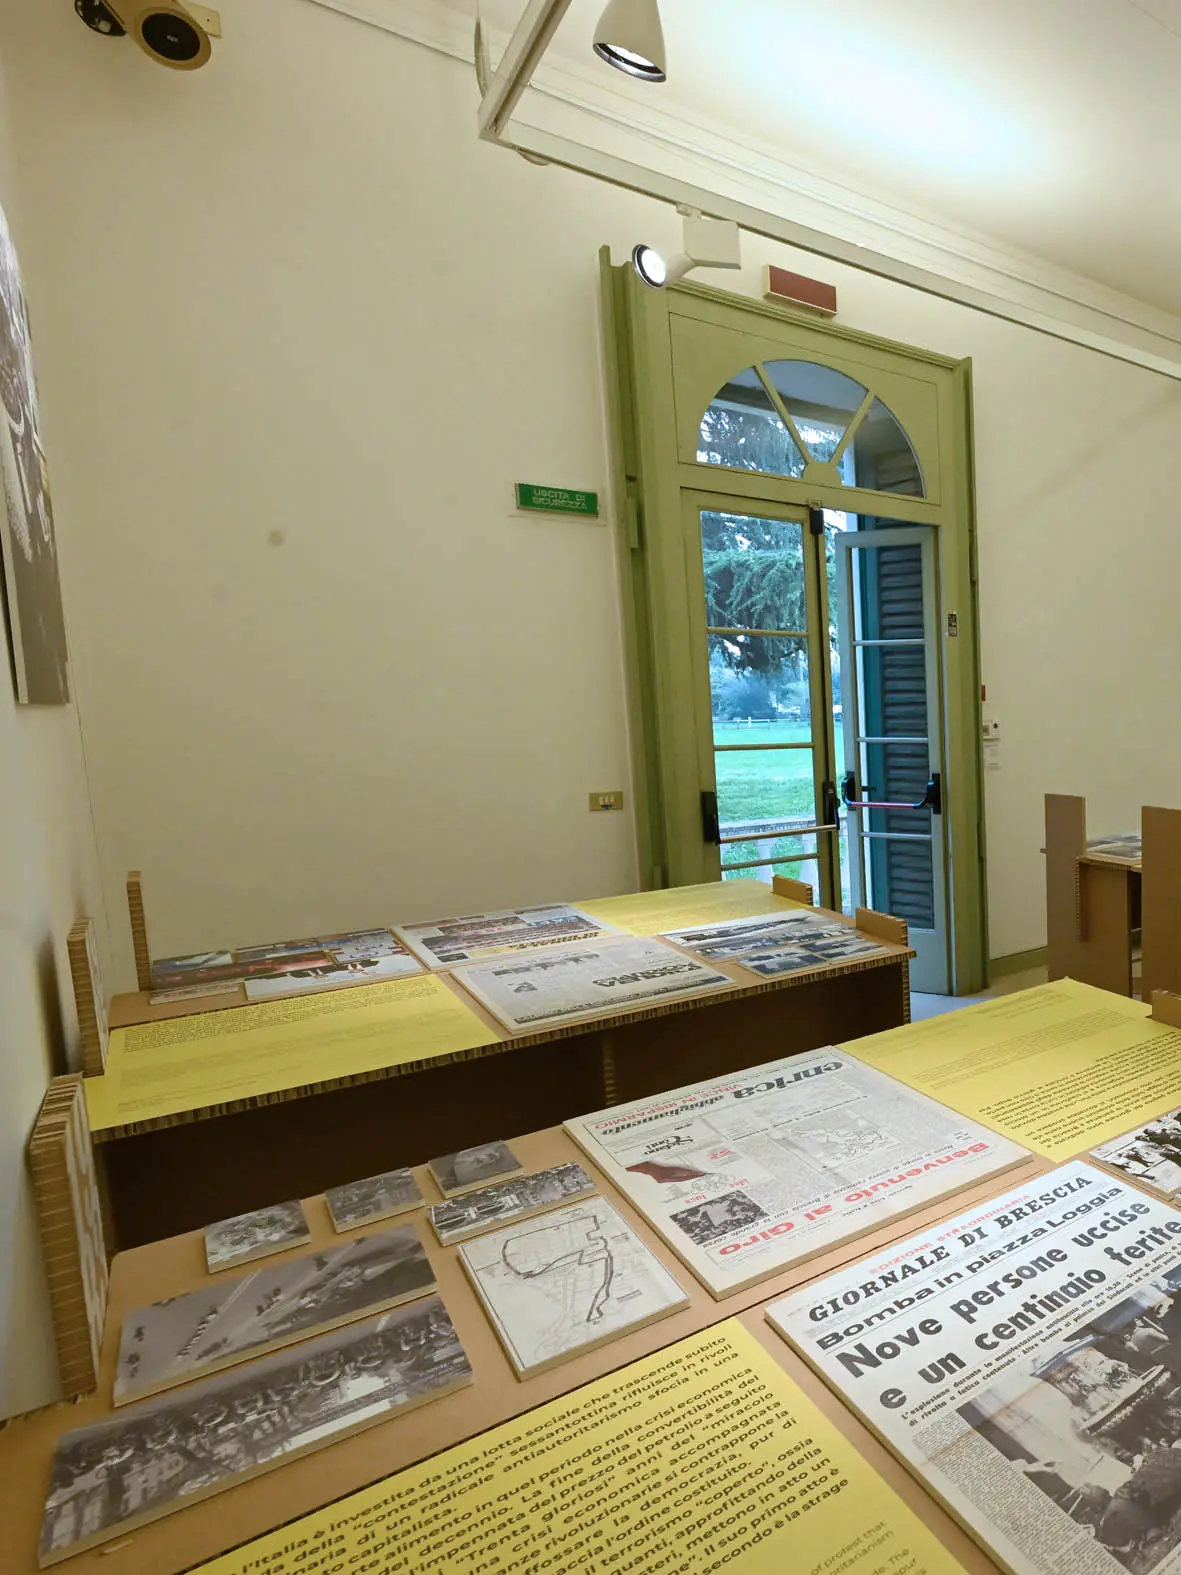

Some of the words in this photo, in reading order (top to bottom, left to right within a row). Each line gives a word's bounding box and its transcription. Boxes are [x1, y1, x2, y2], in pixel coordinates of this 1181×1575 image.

[533, 488, 569, 500] USCITA
[731, 1062, 843, 1099] enrica
[804, 1204, 832, 1221] al
[844, 1142, 988, 1202] Benvenuto
[719, 1222, 795, 1255] Giro
[809, 1245, 950, 1322] GIORNALE
[957, 1226, 989, 1248] DI
[993, 1177, 1093, 1229] BRESCIA
[816, 1288, 935, 1350] Bomba
[934, 1272, 964, 1288] in
[965, 1227, 1048, 1274] piazza
[1045, 1188, 1123, 1228] Loggia
[835, 1318, 943, 1378] Nove
[949, 1249, 1068, 1324] persone
[1071, 1203, 1150, 1247] uccise
[879, 1388, 907, 1409] e
[918, 1352, 967, 1384] un
[971, 1269, 1106, 1351] centinaio
[921, 1401, 947, 1419] rivolta
[1022, 1343, 1039, 1355] Altre
[953, 1369, 982, 1388] durante
[294, 1534, 345, 1563] della
[510, 1401, 617, 1456] sessantottina
[622, 1371, 678, 1401] rifluisce
[682, 1363, 696, 1372] in
[700, 1343, 732, 1363] rivoli
[330, 1487, 415, 1532] investita
[419, 1475, 442, 1488] da
[446, 1456, 479, 1475] una
[482, 1436, 522, 1457] lotta
[525, 1408, 580, 1437] sociale
[583, 1393, 610, 1409] che
[612, 1358, 683, 1394] trascende
[685, 1338, 726, 1359] subito
[357, 1530, 376, 1545] di
[386, 1515, 411, 1531] un
[421, 1474, 494, 1514] radicale
[503, 1401, 642, 1473] antiautoritarismo
[647, 1377, 690, 1400] sfocia
[694, 1368, 708, 1376] in
[713, 1353, 739, 1367] una
[385, 1512, 472, 1561] alimento
[475, 1501, 493, 1513] in
[496, 1477, 535, 1502] quel
[538, 1445, 602, 1482] periodo
[605, 1424, 643, 1446] nella
[645, 1406, 675, 1425] crisi
[677, 1368, 752, 1409] economica
[419, 1507, 513, 1557] decennio.
[521, 1490, 542, 1503] La
[549, 1468, 584, 1488] fine
[591, 1444, 630, 1466] della
[637, 1390, 733, 1442] convertibilità
[738, 1375, 759, 1389] del
[512, 1525, 552, 1552] crisi
[563, 1468, 660, 1524] economica
[669, 1401, 781, 1466] accompagnata
[529, 1494, 557, 1513] del
[559, 1465, 615, 1499] prezzo
[617, 1448, 642, 1466] del
[644, 1418, 703, 1453] petrolio
[715, 1384, 766, 1414] seguito
[545, 1481, 662, 1550] rivoluzionarie
[664, 1470, 678, 1482] si
[680, 1418, 774, 1473] contrappone
[775, 1410, 789, 1420] la
[613, 1515, 630, 1527] la
[640, 1453, 742, 1511] democrazia,
[749, 1431, 774, 1450] pur
[782, 1418, 797, 1429] di
[627, 1451, 662, 1475] anni
[671, 1434, 695, 1451] del
[600, 1510, 693, 1567] terrorismo
[777, 1438, 813, 1461] ossia
[673, 1462, 752, 1507] costituito.
[675, 1470, 785, 1540] approfittando
[787, 1448, 822, 1471] della
[686, 1504, 756, 1550] mettono
[758, 1492, 775, 1504] in
[778, 1472, 808, 1493] atto
[811, 1458, 831, 1472] un
[704, 1544, 716, 1556] Il
[718, 1526, 748, 1548] suo
[750, 1496, 796, 1529] primo
[799, 1475, 828, 1497] atto
[785, 1510, 801, 1522] la
[802, 1479, 848, 1512] strage
[348, 1508, 457, 1564] capitalista.
[824, 1537, 863, 1568] protest
[862, 1520, 887, 1539] that
[887, 1547, 910, 1566] The
